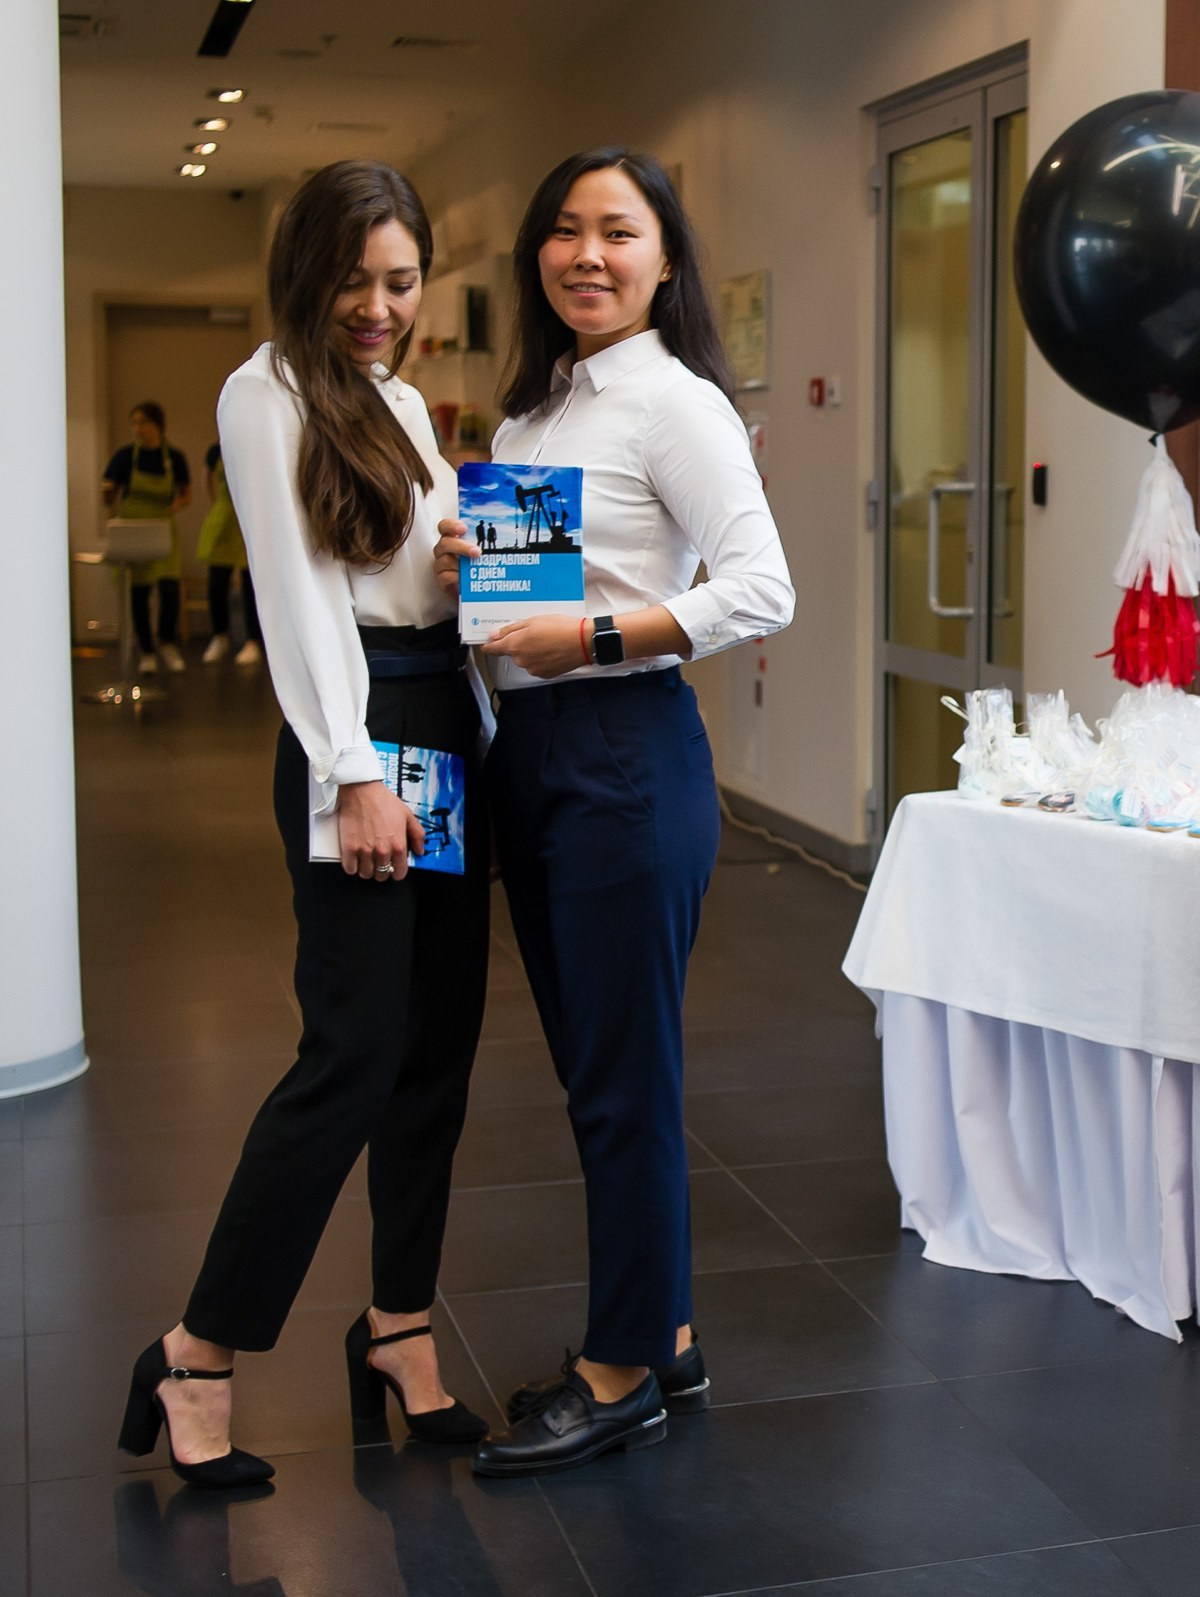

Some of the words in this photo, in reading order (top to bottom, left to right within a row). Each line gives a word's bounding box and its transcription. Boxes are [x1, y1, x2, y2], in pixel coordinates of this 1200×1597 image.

[470, 567, 477, 579] С
[478, 567, 506, 580] ДНЕМ
[470, 580, 531, 592] НЕФТЯНИКА!
